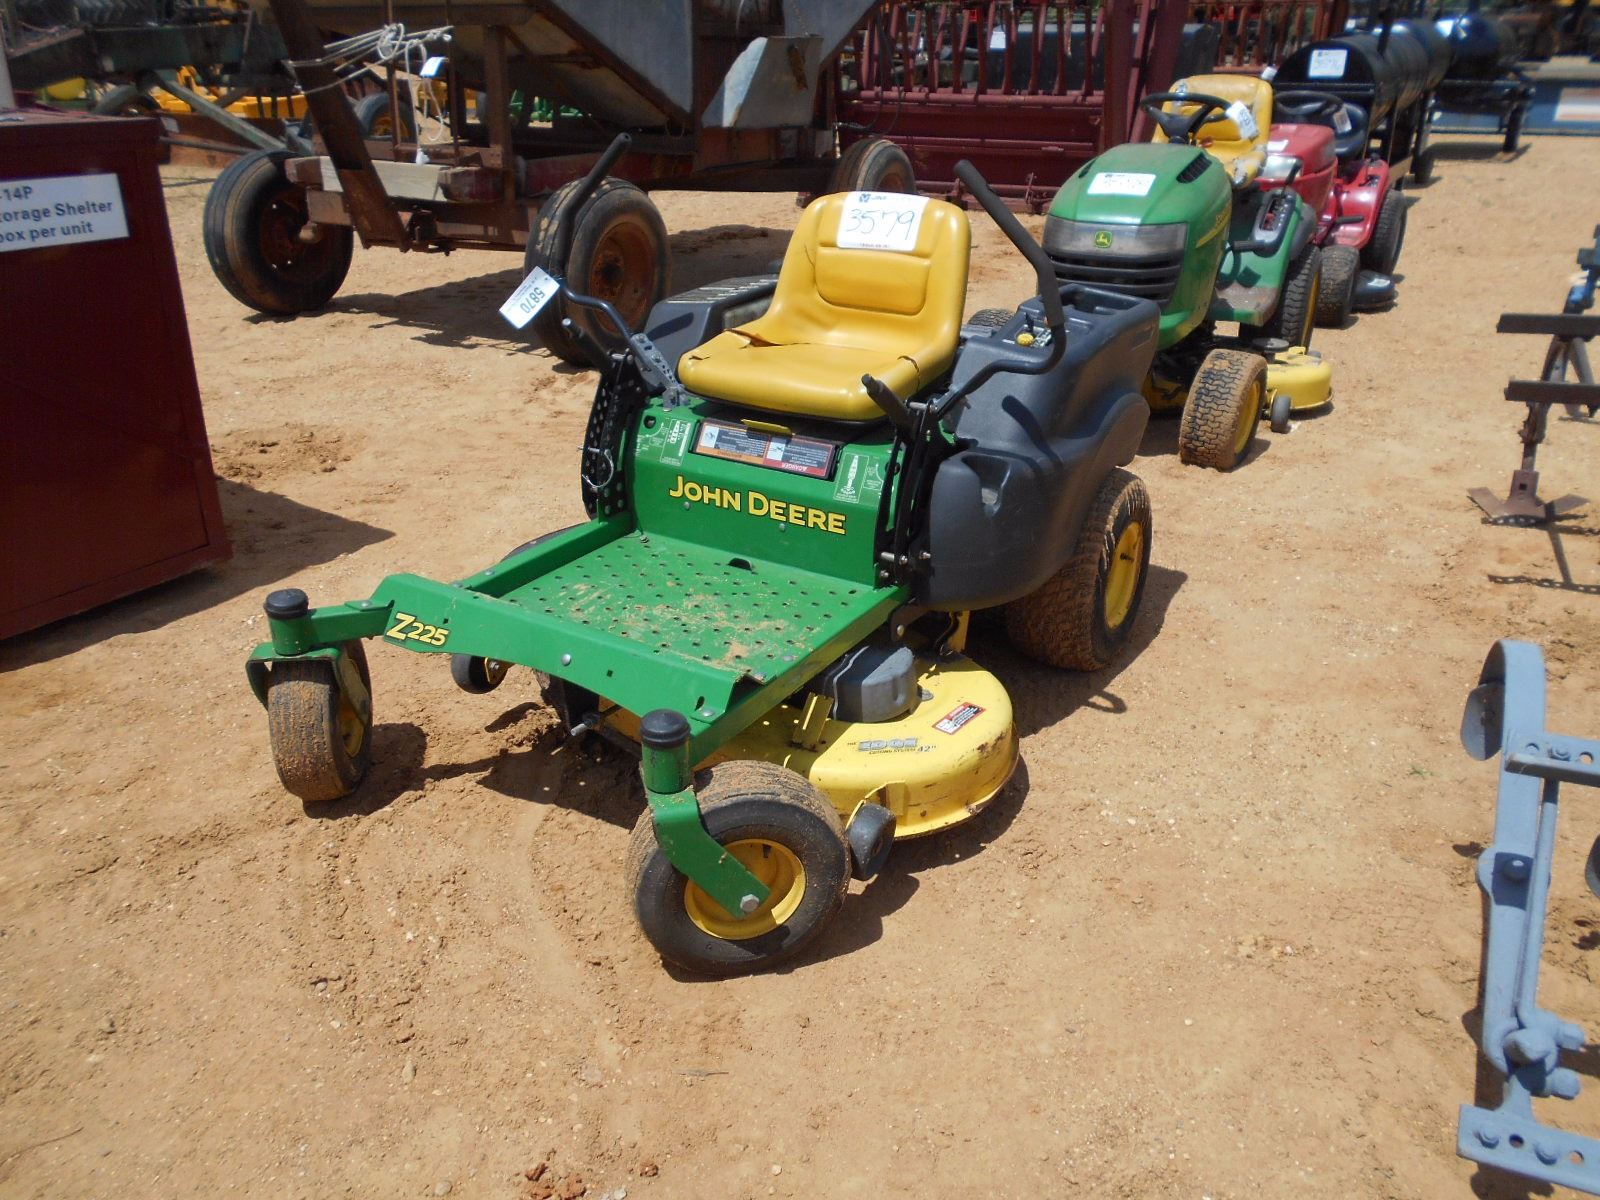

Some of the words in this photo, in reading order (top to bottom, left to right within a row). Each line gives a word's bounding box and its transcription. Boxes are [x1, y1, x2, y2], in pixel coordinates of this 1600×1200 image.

[54, 200, 113, 217] Shelter
[29, 226, 57, 241] per
[60, 220, 94, 236] unit
[845, 208, 916, 241] 3579
[519, 286, 546, 314] 5870
[669, 475, 741, 512] JOHN
[748, 490, 846, 535] DEERE
[386, 612, 450, 646] Z225
